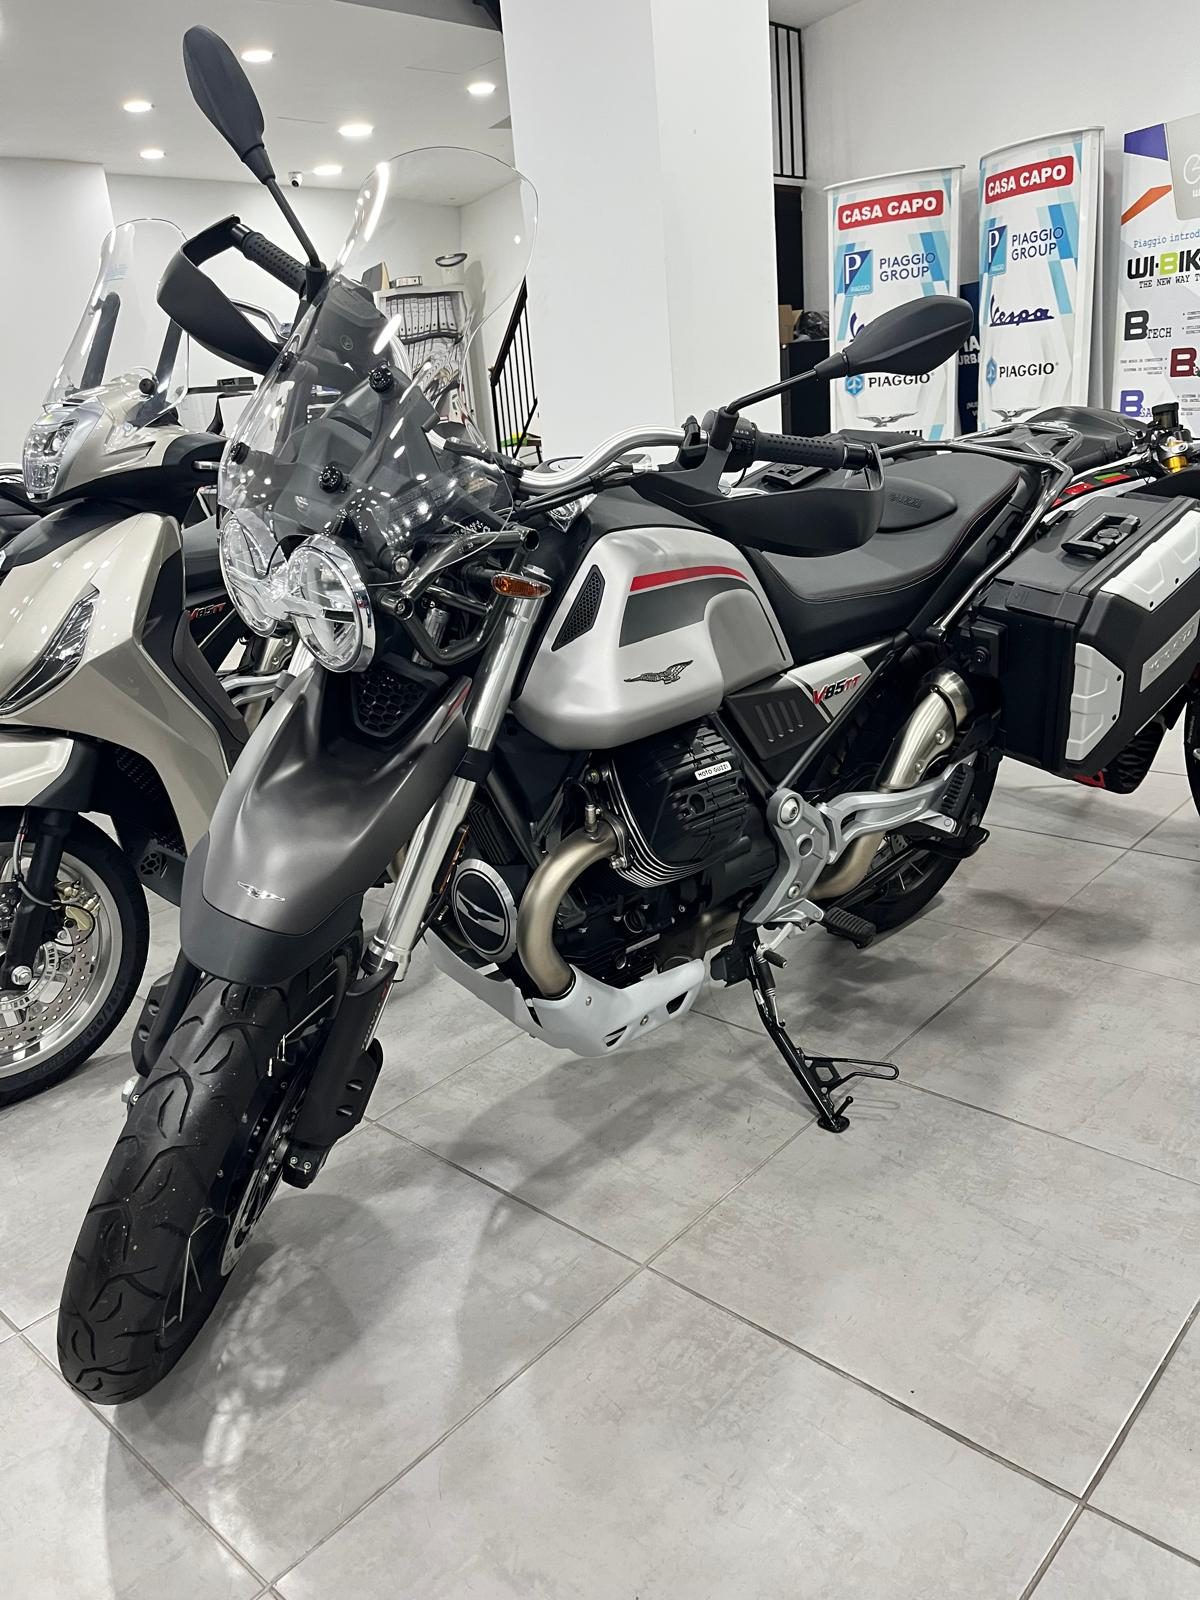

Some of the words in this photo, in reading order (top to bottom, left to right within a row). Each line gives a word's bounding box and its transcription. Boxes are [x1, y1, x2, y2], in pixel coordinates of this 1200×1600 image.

[988, 176, 1016, 197] CASA
[1020, 165, 1066, 187] CAPO
[842, 205, 883, 224] CASA
[887, 197, 937, 216] CAPO
[1012, 227, 1064, 246] PIAGGIO
[1133, 236, 1167, 248] Piaggio
[880, 252, 936, 269] PIAGGIO
[1011, 243, 1057, 261] GROUP
[880, 266, 929, 282] GROUP
[1139, 280, 1152, 288] THE
[1157, 277, 1171, 287] NEW
[1175, 274, 1190, 284] WAY
[989, 294, 1055, 327] Vespa
[999, 362, 1055, 378] PIAGGIO
[868, 373, 931, 388] PIAGGIO
[813, 673, 862, 705] V85TT
[697, 769, 712, 778] MOTO
[713, 764, 729, 773] GUZZI
